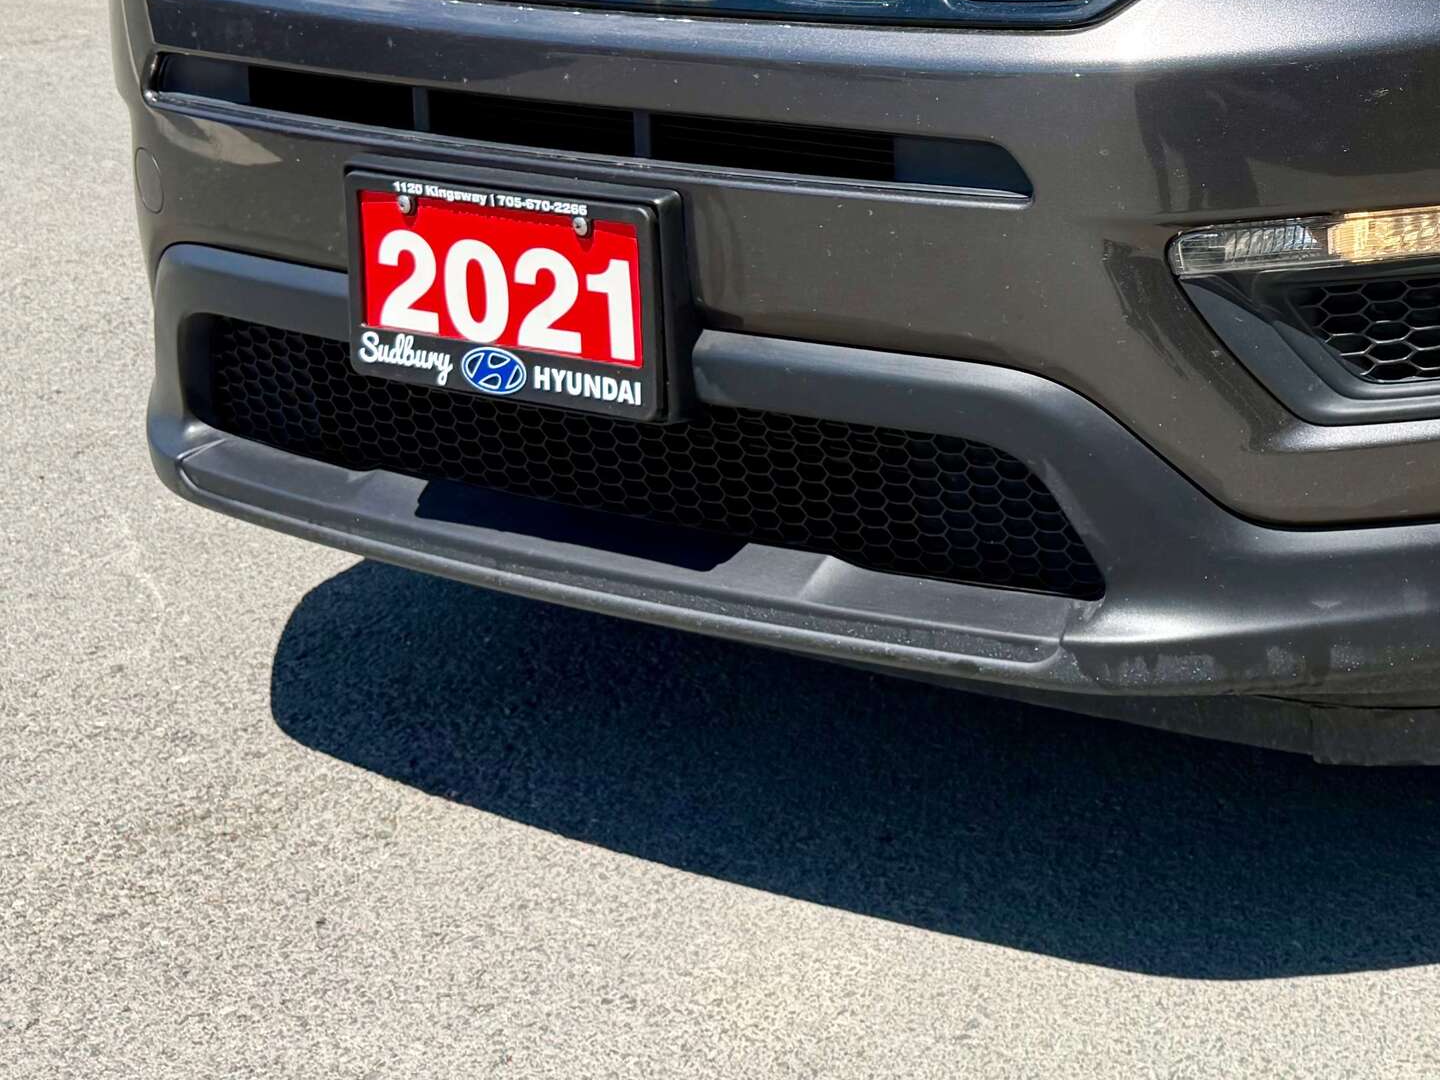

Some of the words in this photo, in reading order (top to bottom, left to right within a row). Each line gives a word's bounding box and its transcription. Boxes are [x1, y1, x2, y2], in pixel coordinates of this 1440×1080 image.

[393, 180, 423, 195] 1120
[424, 184, 488, 207] Kingsway
[377, 228, 637, 362] 2021
[358, 330, 454, 387] Sudbury
[533, 365, 643, 406] HYUNDAI
